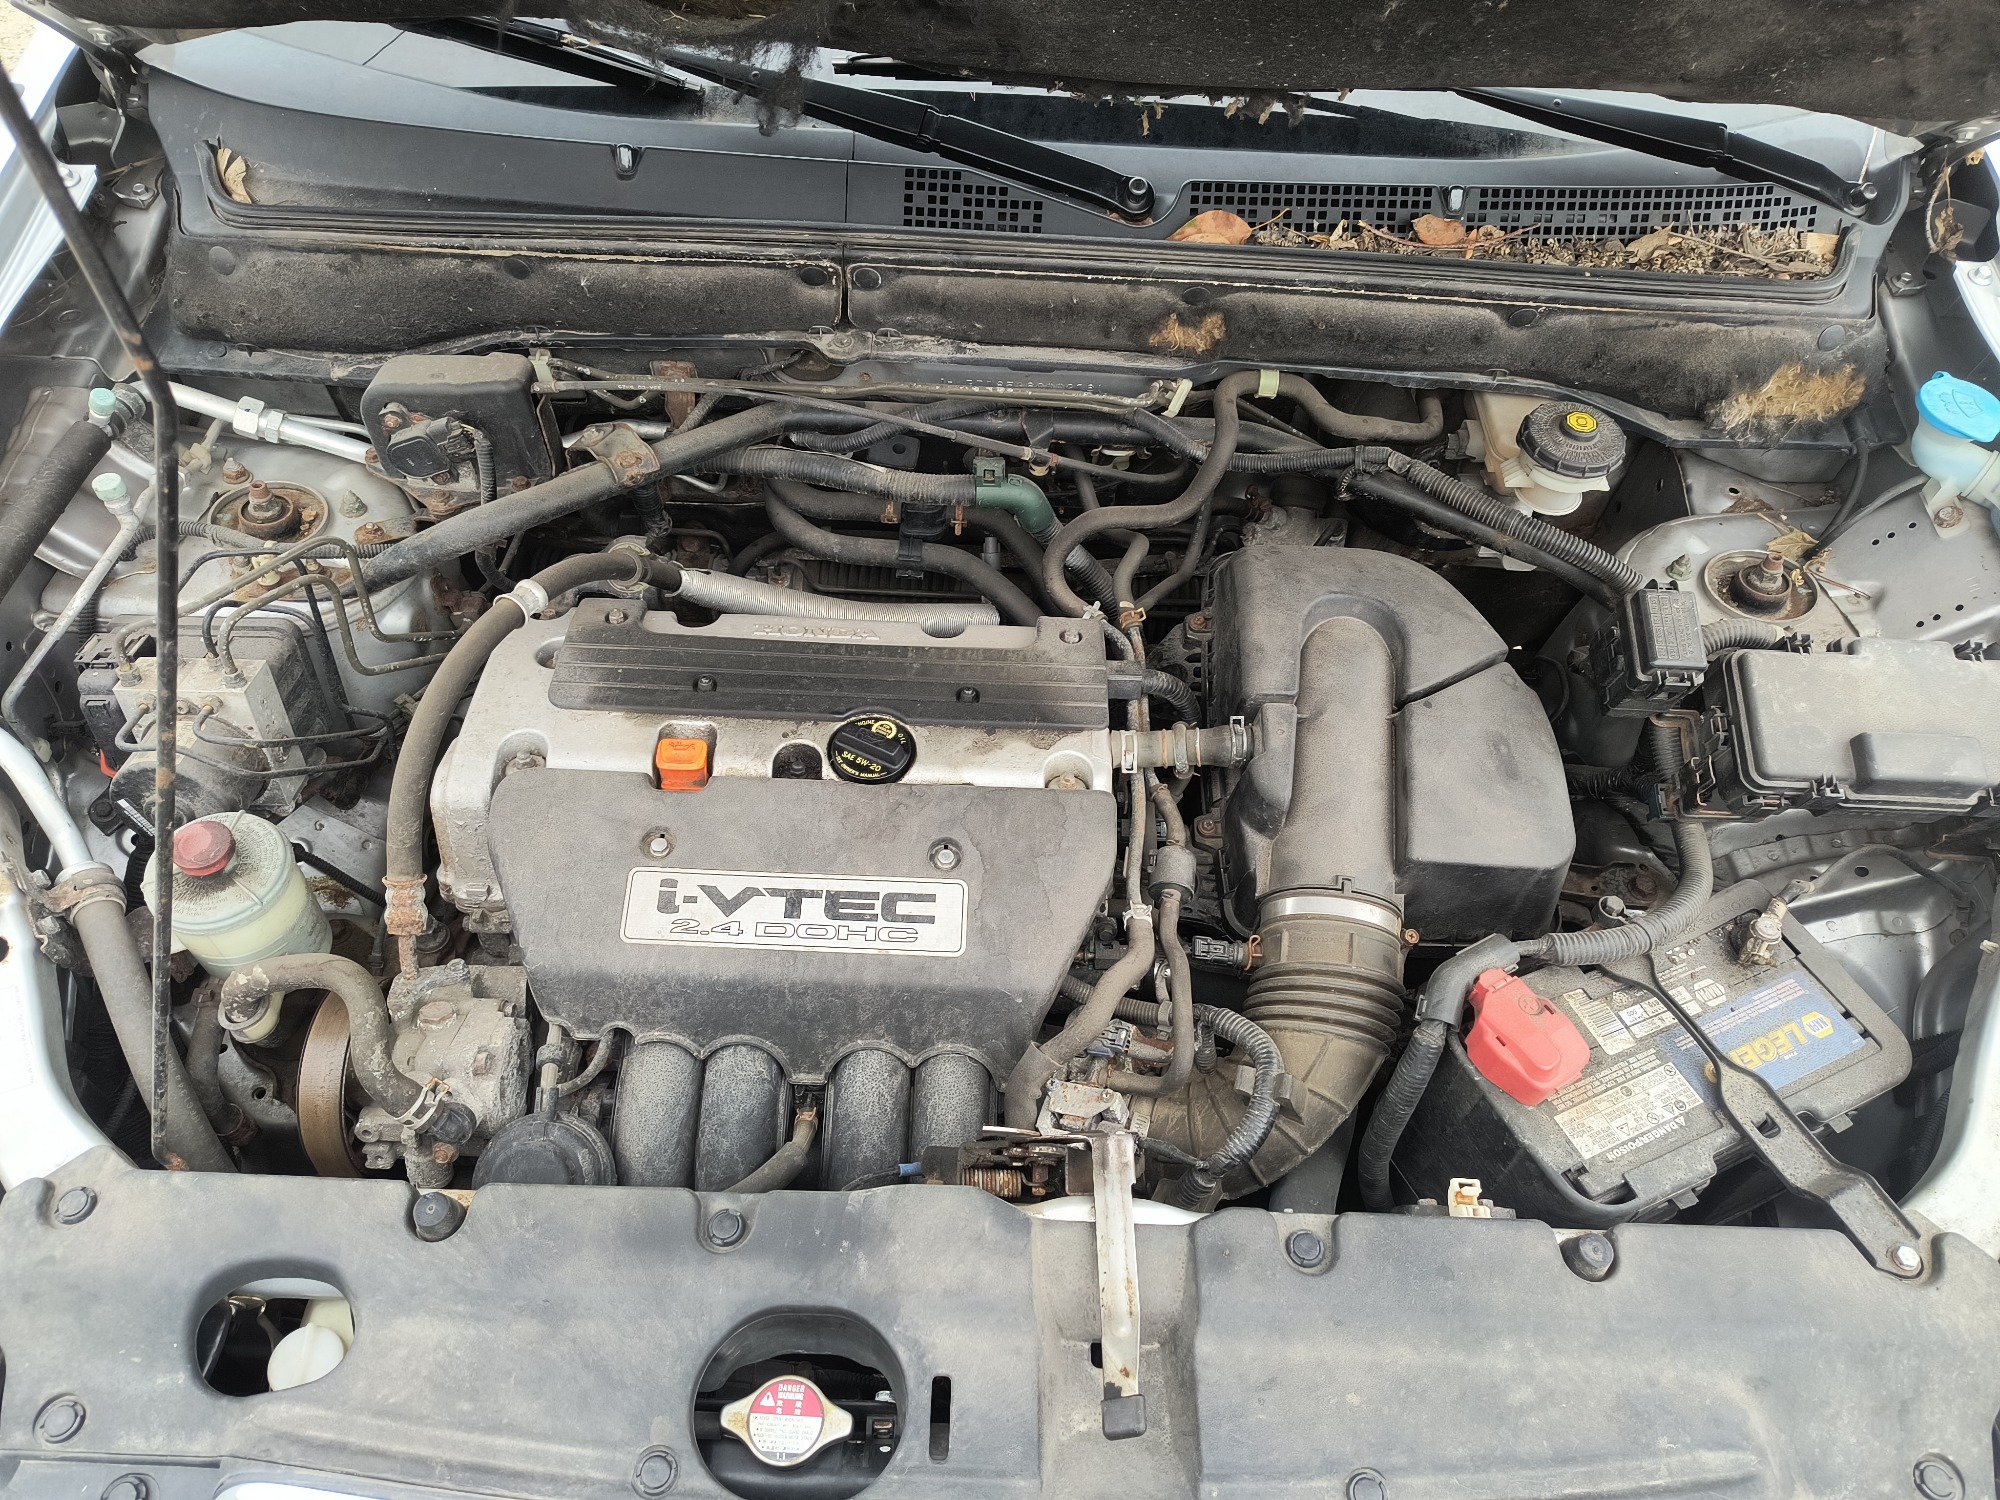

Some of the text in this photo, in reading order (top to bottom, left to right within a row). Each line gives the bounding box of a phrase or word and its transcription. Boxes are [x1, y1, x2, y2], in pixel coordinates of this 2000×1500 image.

[753, 624, 880, 641] HONDA
[897, 733, 907, 745] OIL
[841, 751, 881, 772] SAE 5W-20
[656, 877, 937, 925] i-VTEC
[669, 918, 919, 943] 2.4 DOHC
[1783, 1051, 1798, 1060] THE
[1606, 1123, 1678, 1161] DANGER/POISON
[778, 1384, 805, 1392] DANGER
[777, 1392, 804, 1400] WARNING
[776, 1452, 786, 1460] 1.1
